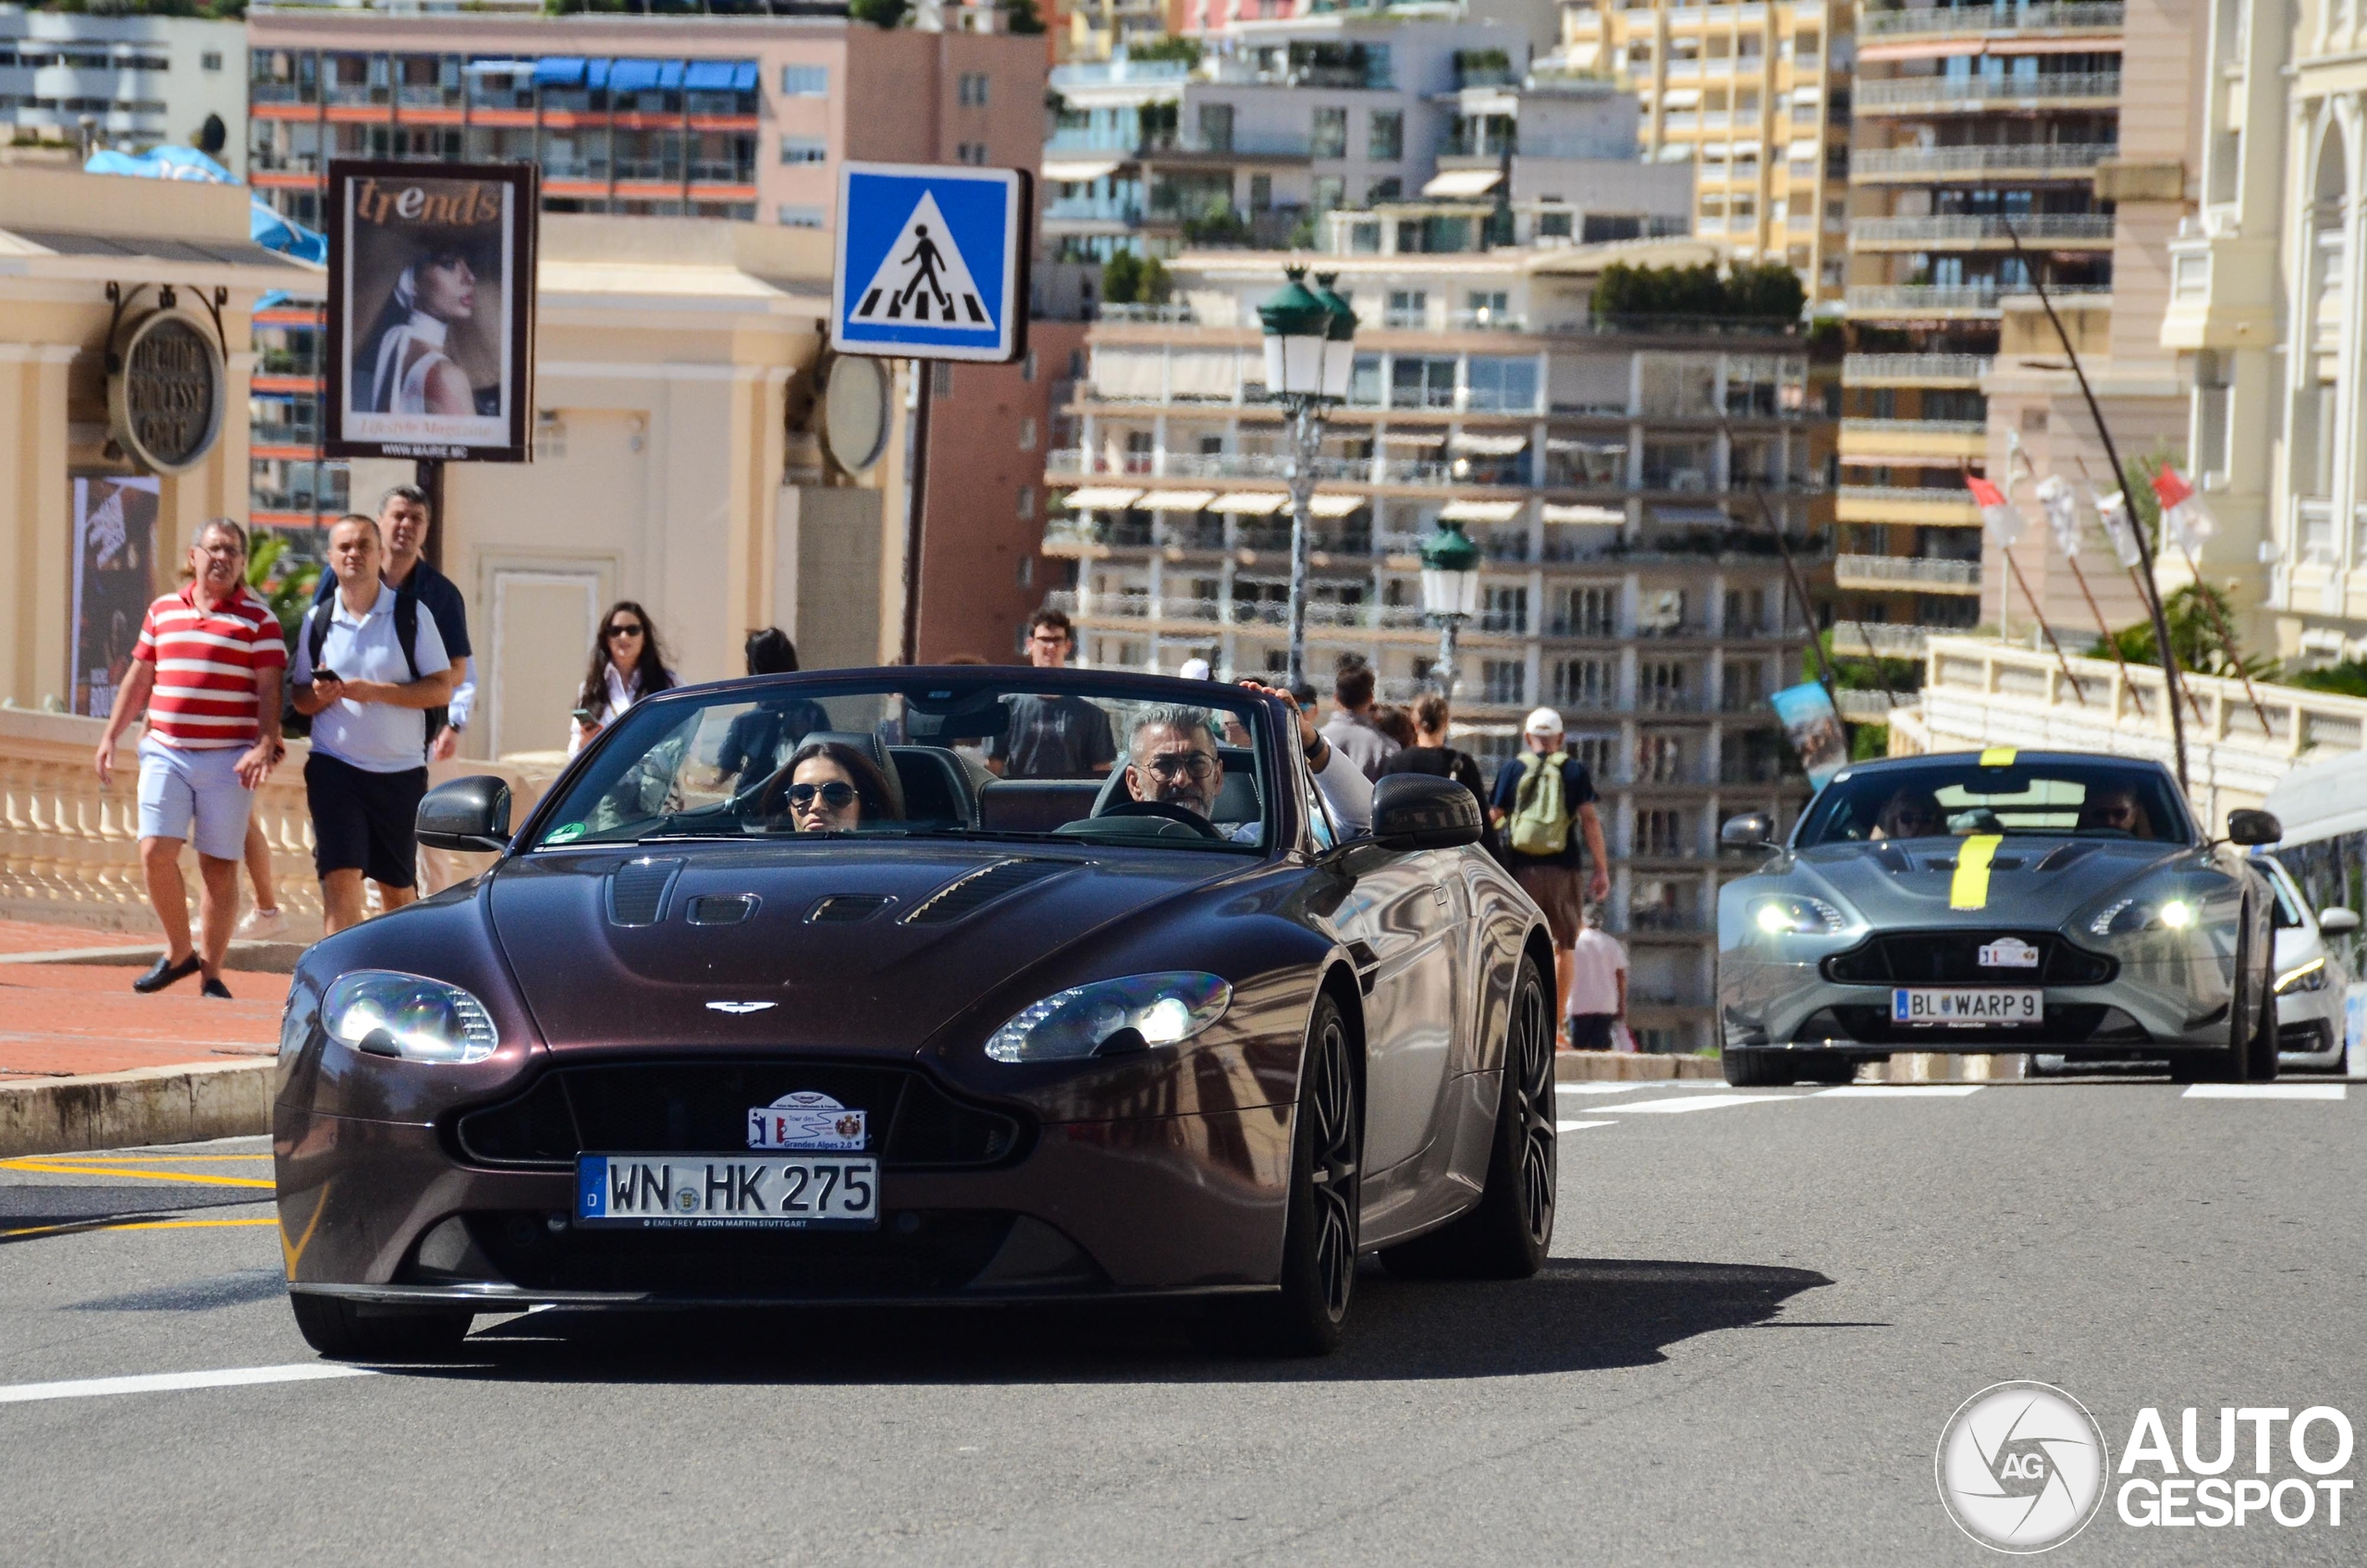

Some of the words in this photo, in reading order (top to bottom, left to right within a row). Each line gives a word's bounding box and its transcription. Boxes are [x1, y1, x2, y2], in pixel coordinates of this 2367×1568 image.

[357, 177, 501, 227] trends
[1912, 995, 1936, 1016] BL
[1956, 995, 2016, 1016] WARP
[2022, 995, 2035, 1016] 9
[784, 1140, 816, 1148] Grandes
[817, 1142, 839, 1150] Alpes
[609, 1163, 670, 1212] WN
[703, 1164, 767, 1212] HK
[780, 1165, 872, 1212] 275
[587, 1194, 597, 1207] D
[758, 1219, 807, 1228] STUTTGART
